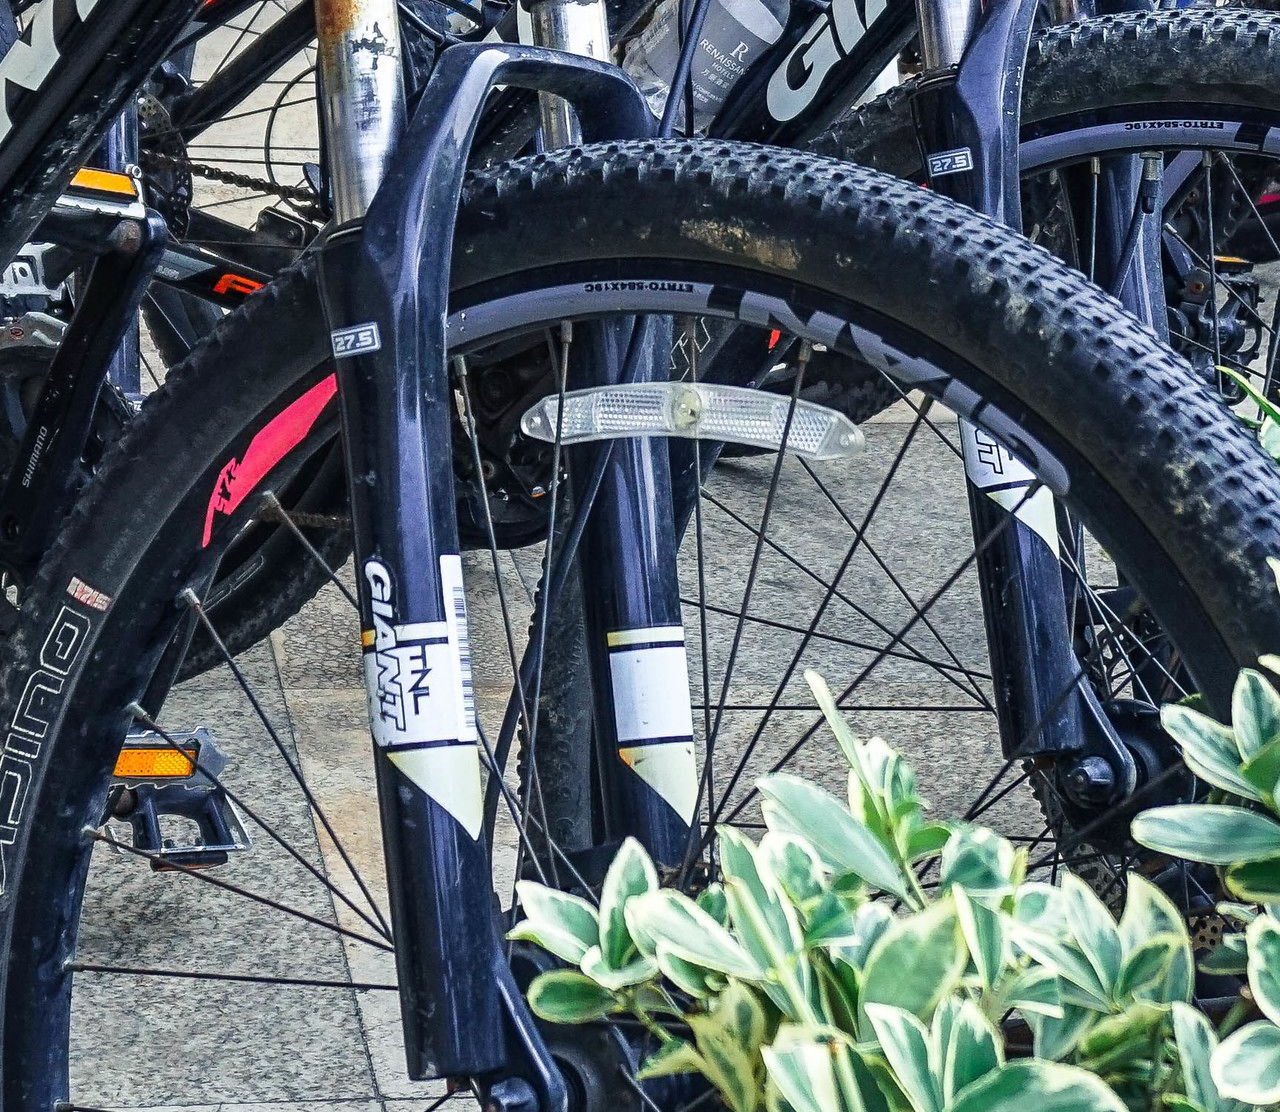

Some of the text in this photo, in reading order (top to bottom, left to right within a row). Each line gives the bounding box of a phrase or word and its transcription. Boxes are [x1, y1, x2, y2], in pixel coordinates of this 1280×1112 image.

[700, 38, 746, 76] RENAISSAN
[932, 153, 969, 172] 27.5
[334, 331, 373, 353] 27.5
[21, 425, 48, 488] SHIMANO
[364, 560, 407, 732] GIANT
